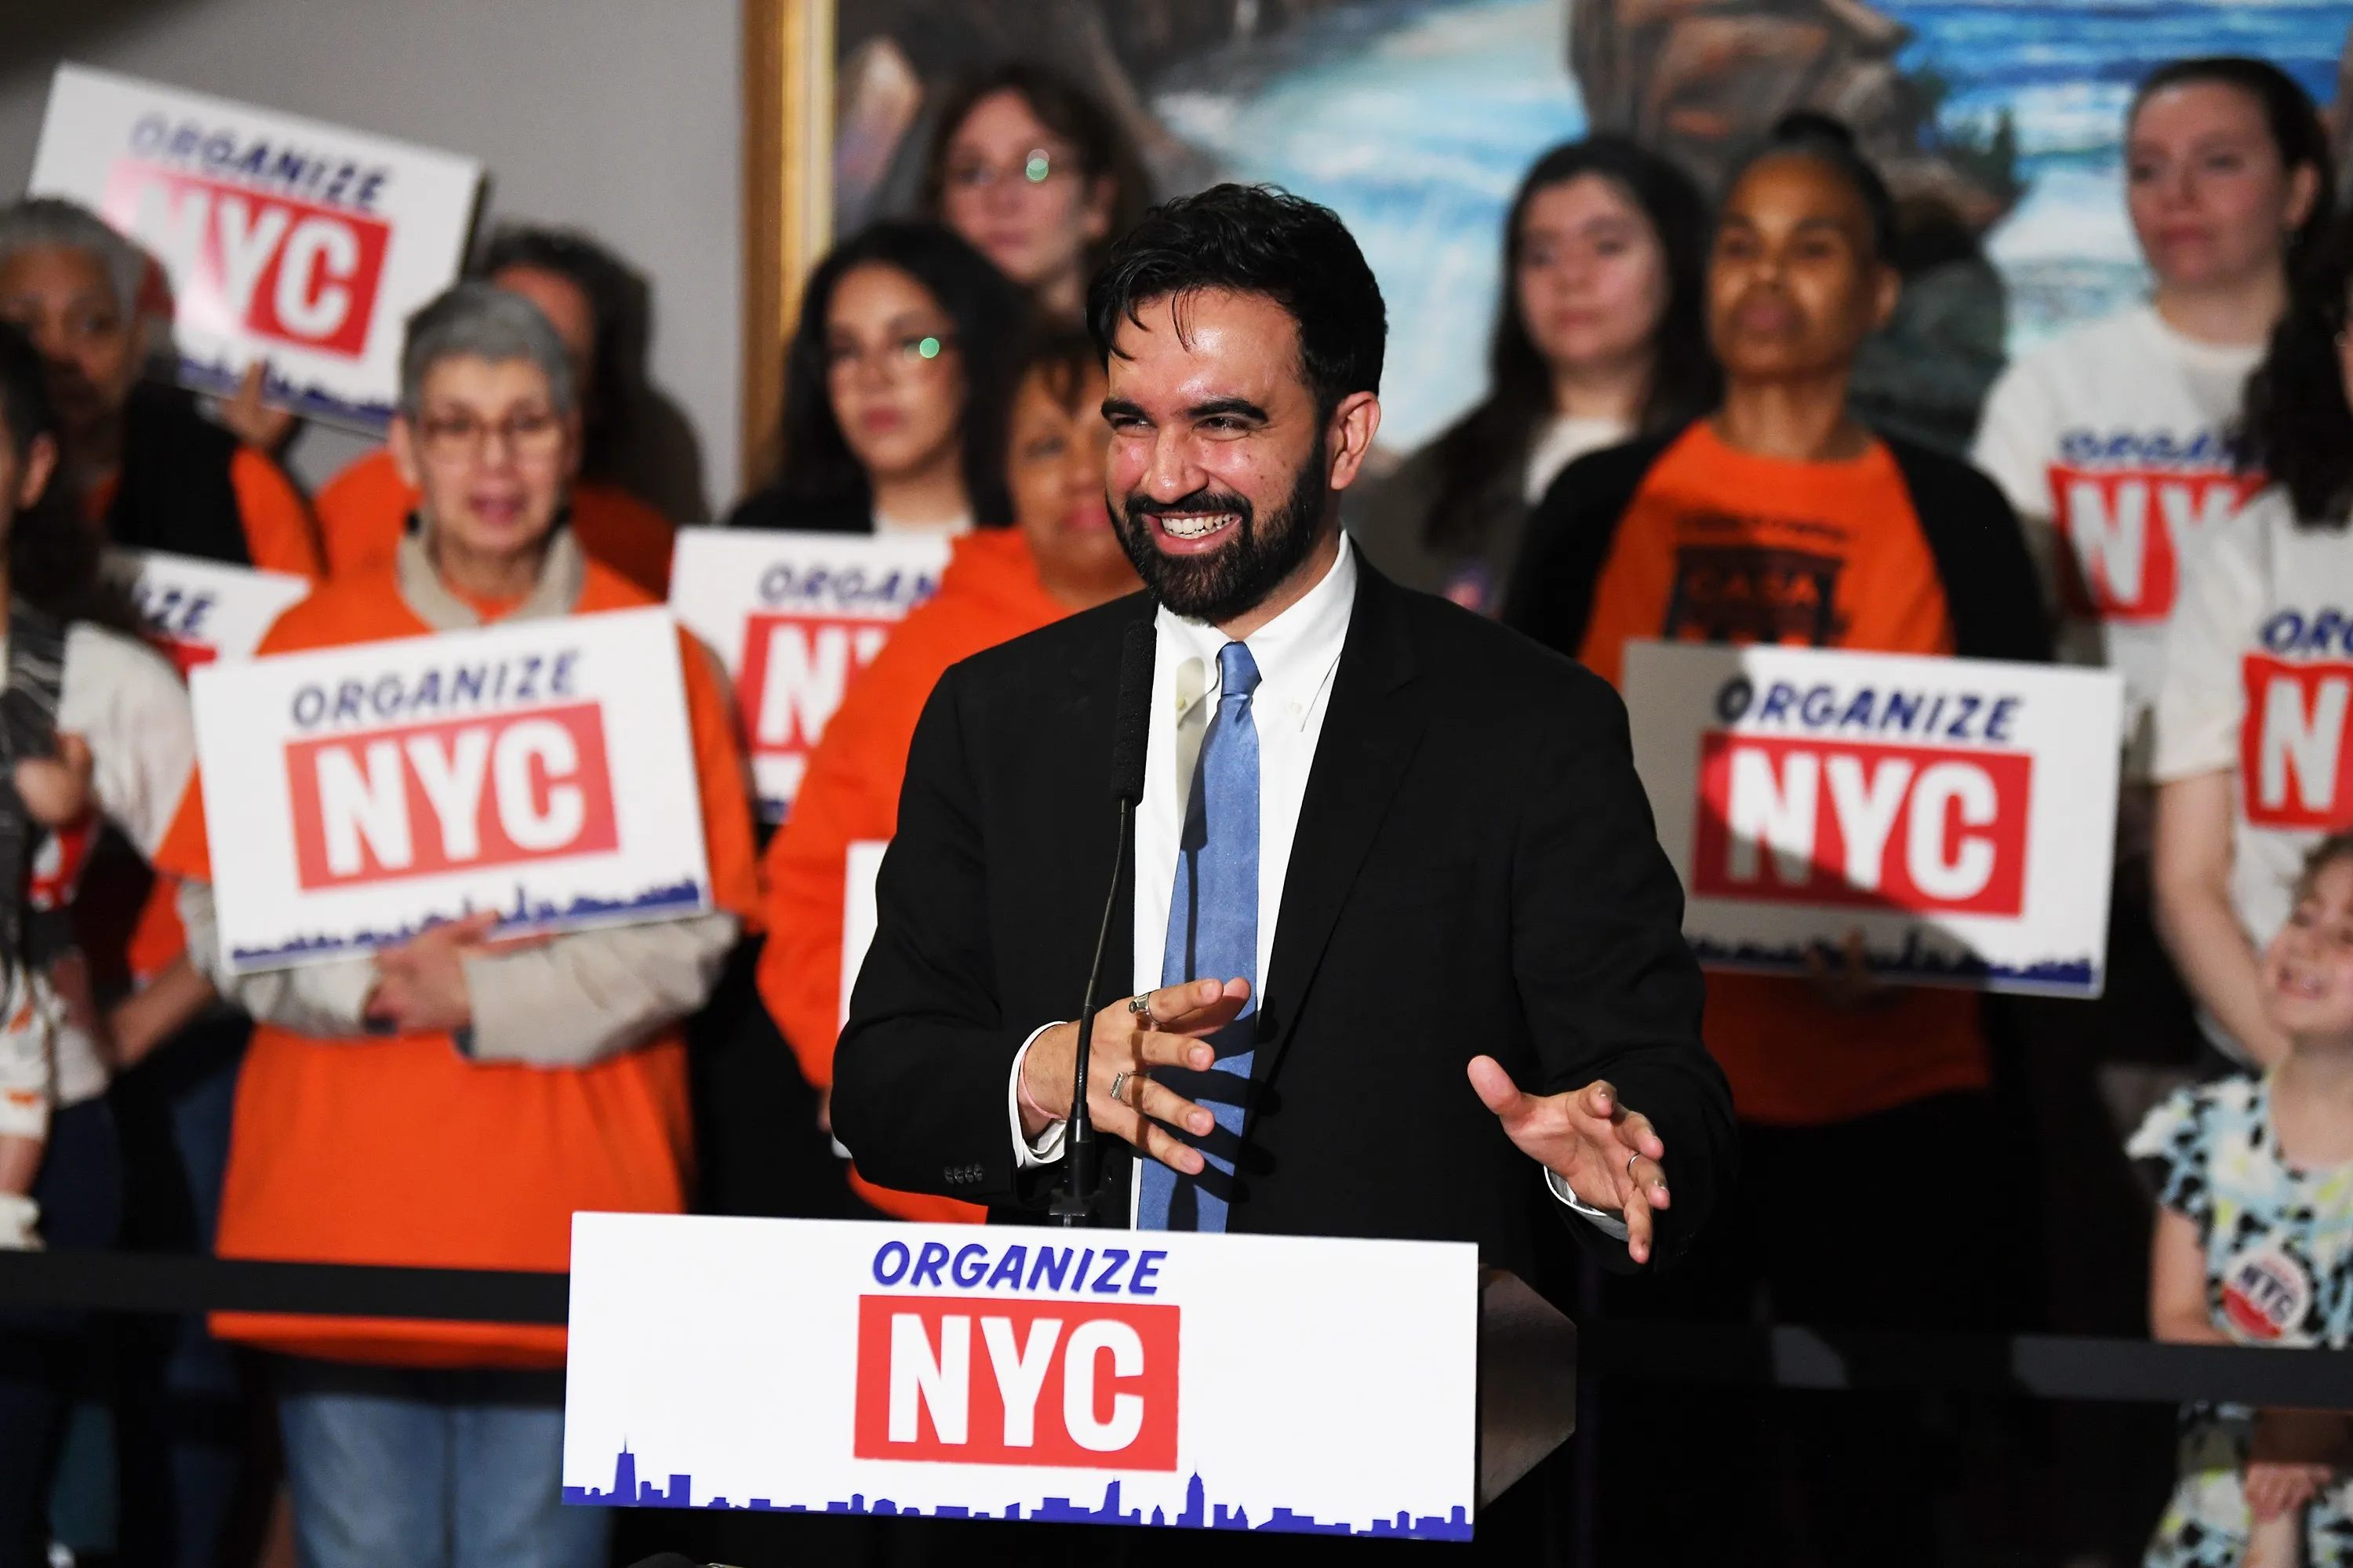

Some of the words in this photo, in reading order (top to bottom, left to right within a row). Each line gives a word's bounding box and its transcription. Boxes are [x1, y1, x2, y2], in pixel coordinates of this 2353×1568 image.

[129, 111, 387, 213] ORGANIZE
[293, 649, 581, 726] ORGANIZE
[1717, 676, 2021, 741] ORGANIZE
[317, 719, 584, 876] NYC
[1728, 748, 1997, 900] NYC
[872, 1241, 1166, 1294] ORGANIZE
[889, 1313, 1144, 1452] NYC
